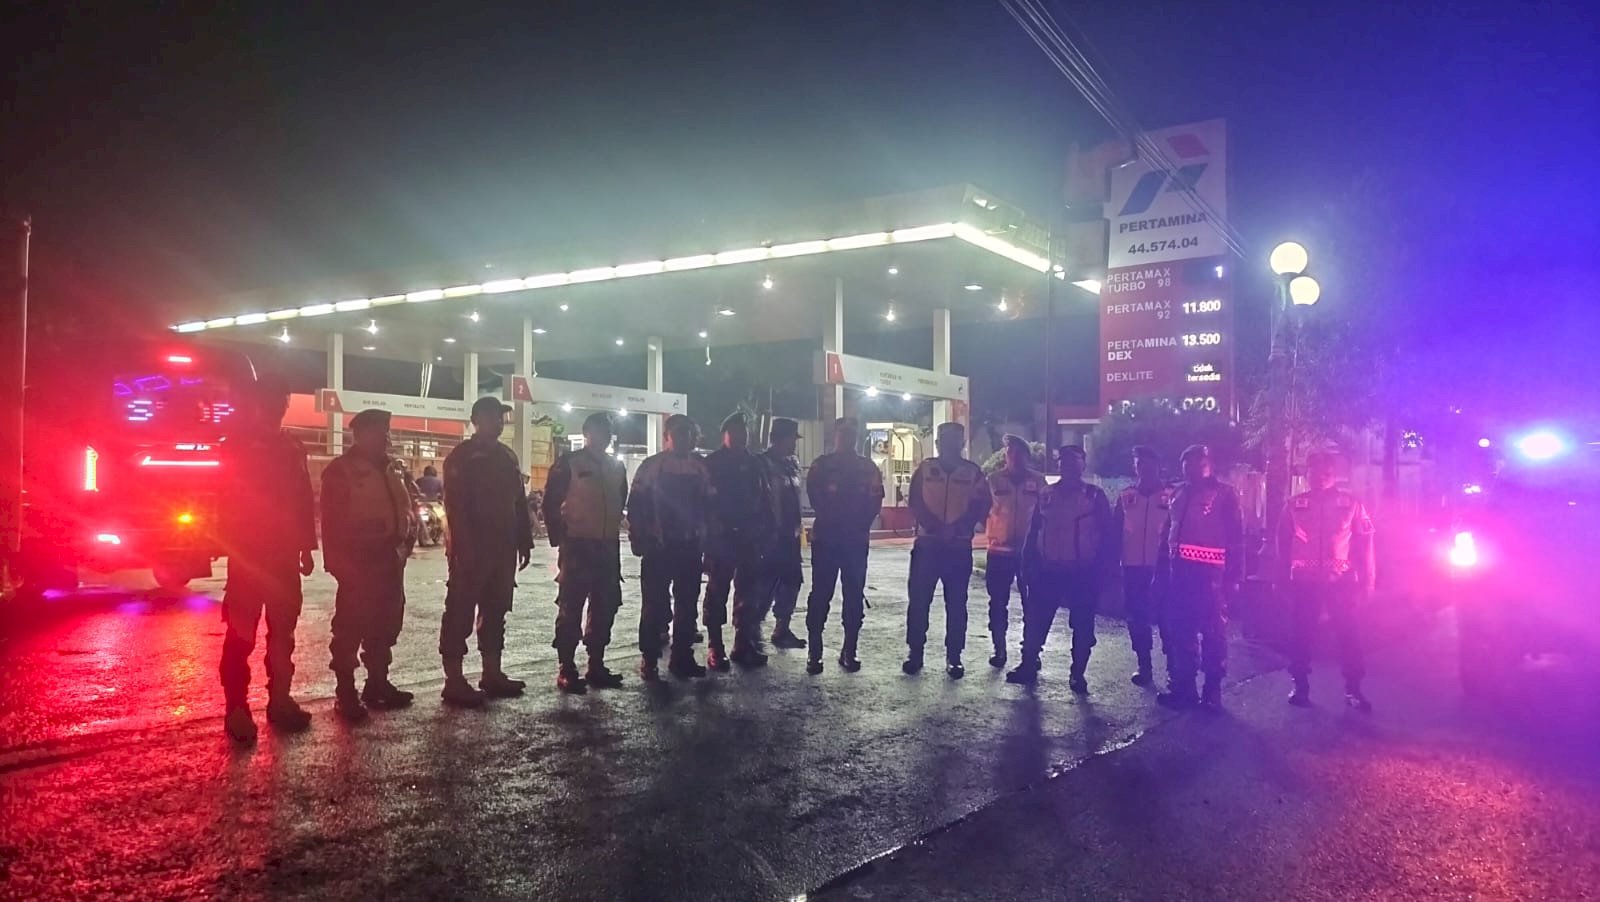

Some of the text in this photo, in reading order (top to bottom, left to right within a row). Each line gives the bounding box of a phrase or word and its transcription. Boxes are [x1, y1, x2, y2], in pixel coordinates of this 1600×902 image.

[1119, 212, 1207, 234] PERTAMINA
[1127, 236, 1199, 255] 44.574.04
[1106, 267, 1171, 284] PERTAMAX
[1107, 278, 1171, 294] TURBO 98
[1106, 299, 1221, 315] PERTAMAX 11.800
[1156, 310, 1171, 320] 92
[1107, 333, 1221, 351] PERTAMINA 13.500
[1107, 350, 1133, 361] DEX
[1106, 370, 1153, 382] DEXLITE
[519, 385, 524, 394] 2
